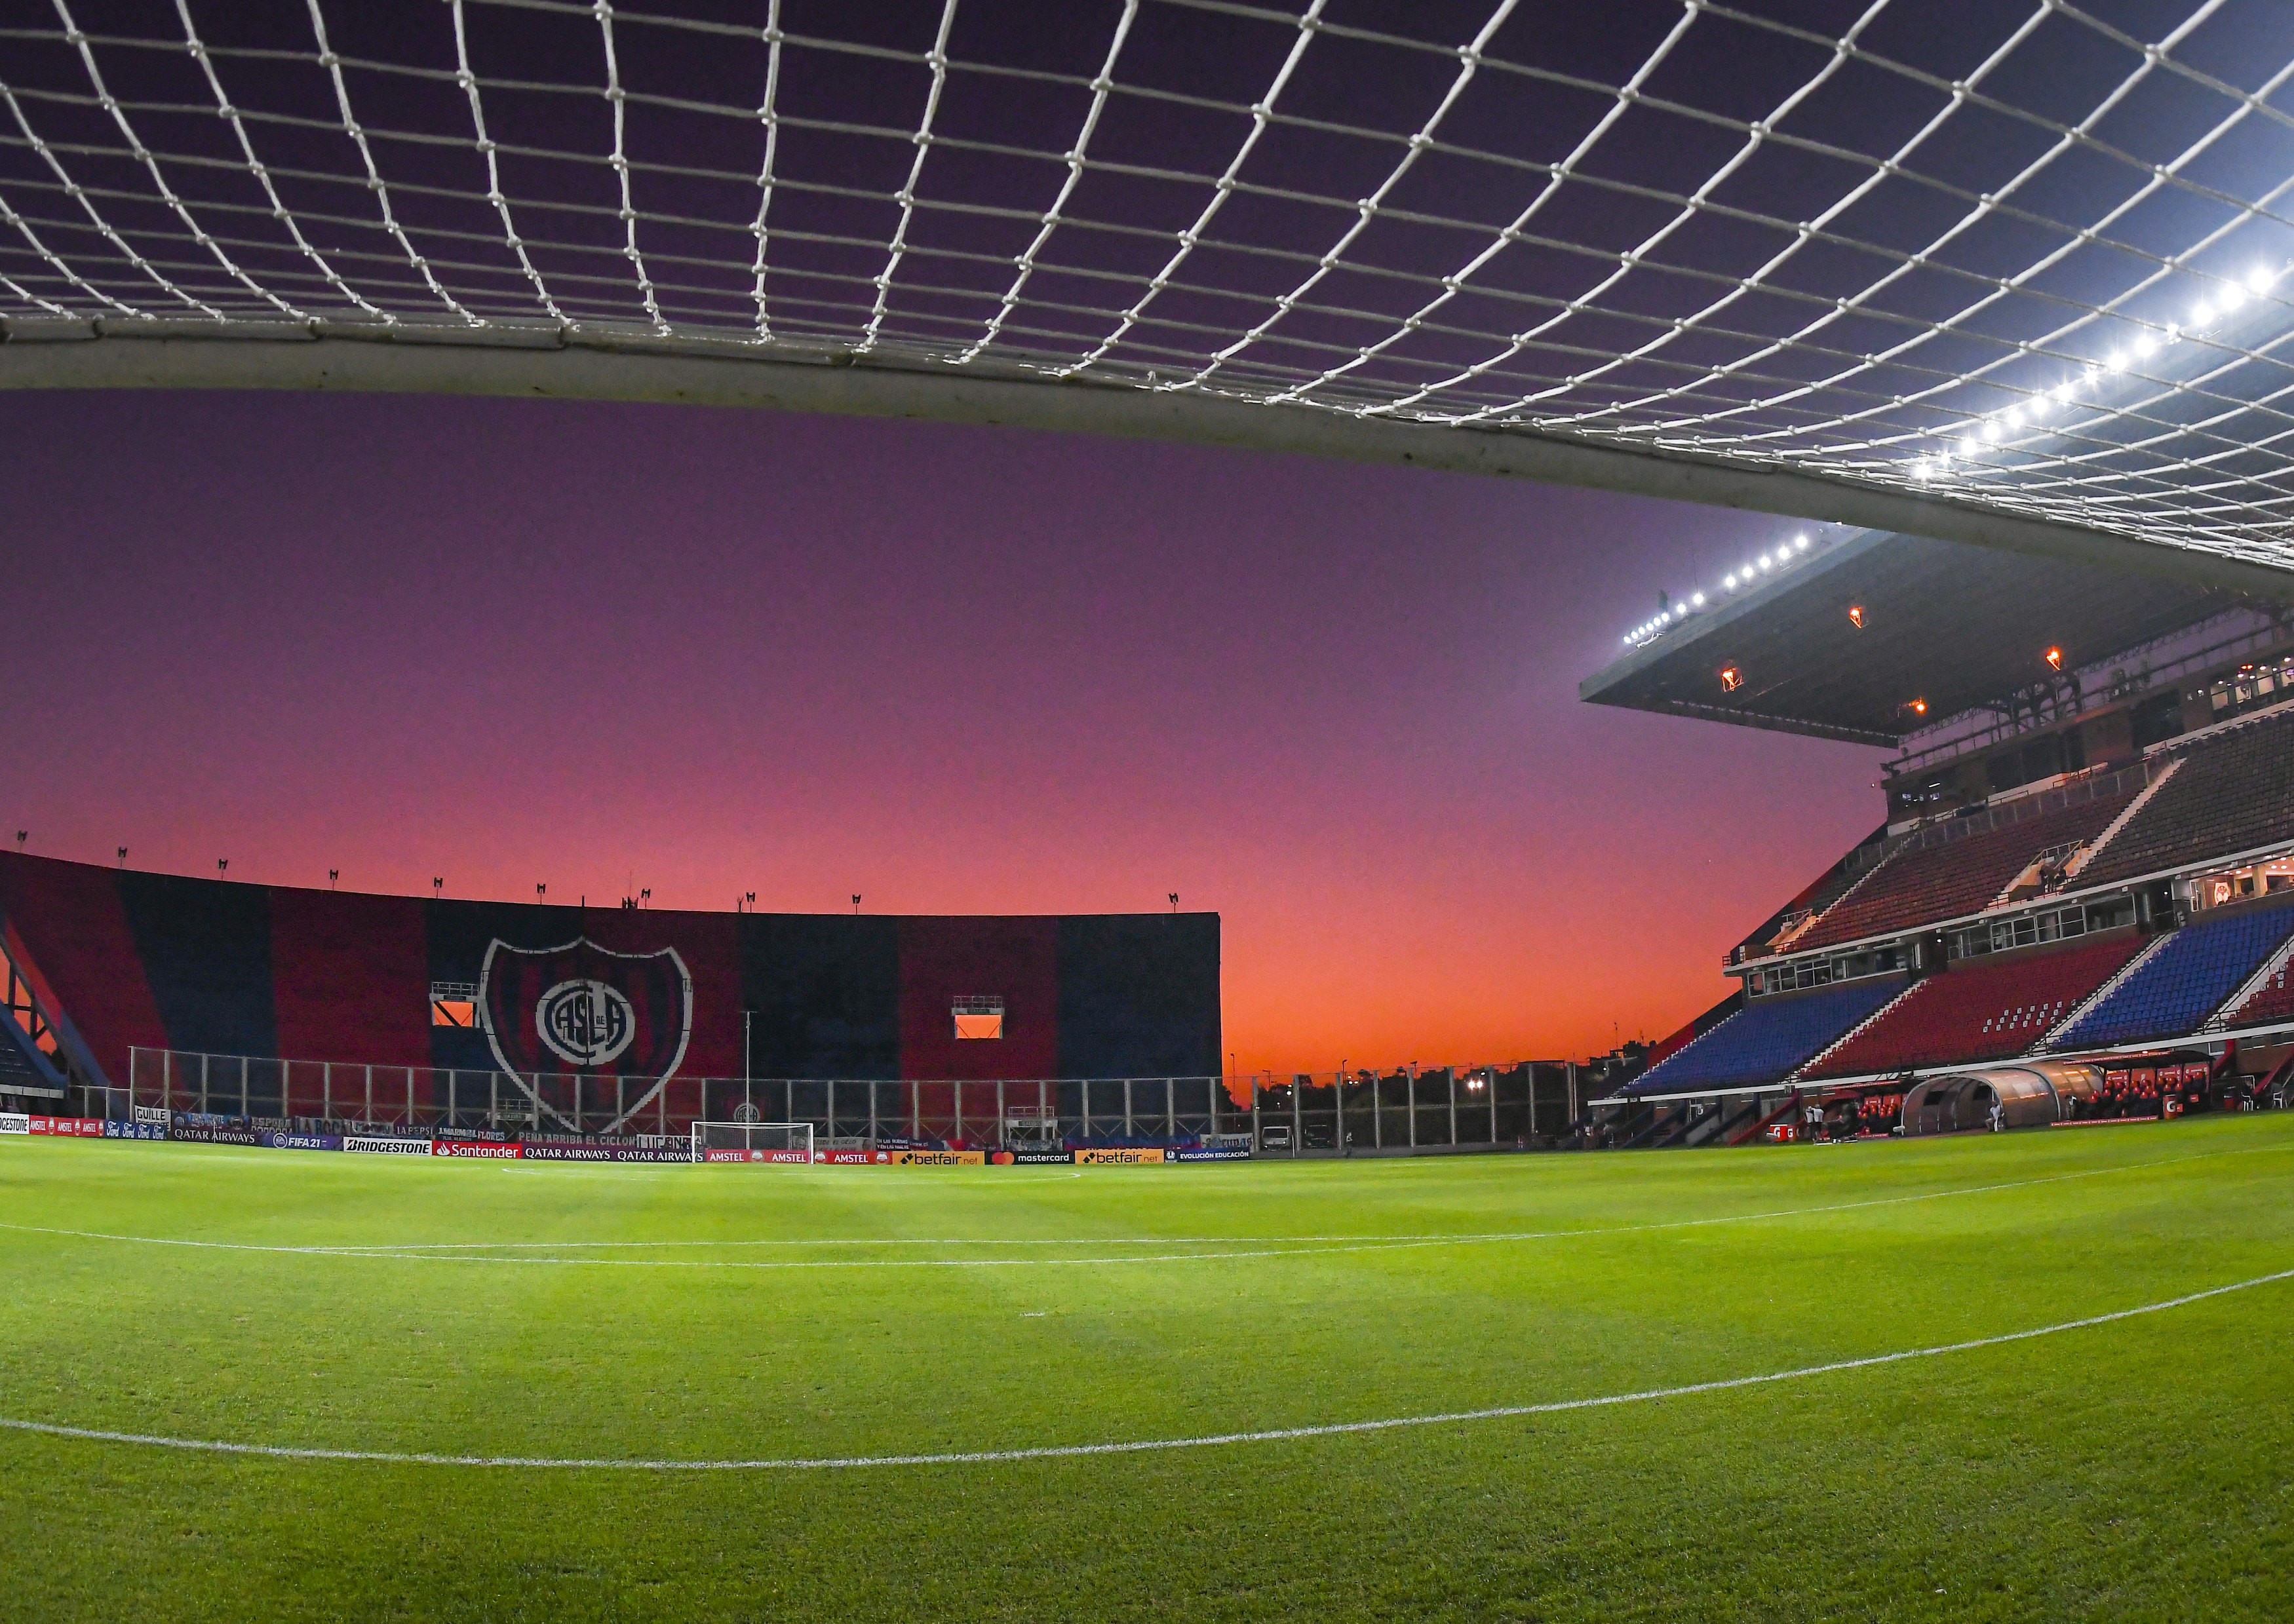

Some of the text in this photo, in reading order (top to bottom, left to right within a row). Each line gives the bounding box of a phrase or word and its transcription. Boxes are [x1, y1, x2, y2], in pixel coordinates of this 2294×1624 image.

[2166, 1100, 2176, 1113] G
[30, 1120, 46, 1131] AMSTEL
[58, 1122, 72, 1132] AMSTEL
[83, 1123, 96, 1132] AMSTEL
[106, 1121, 119, 1137] Ford
[122, 1122, 135, 1138] Ford
[138, 1123, 150, 1138] Ford
[397, 1126, 406, 1134] LA
[408, 1127, 433, 1135] PEPSI
[153, 1125, 164, 1140] Ford
[174, 1129, 255, 1144] QATAR AIRWAYS
[478, 1130, 505, 1140] FLORES
[1787, 1128, 1793, 1138] G
[288, 1137, 321, 1148] FIFA 21
[586, 1135, 596, 1145] EL
[347, 1139, 430, 1153] BRIDGESTONE
[452, 1144, 517, 1158] Santander
[525, 1148, 610, 1159] QATAR AIRWAYS
[617, 1151, 654, 1161] QATAR
[710, 1153, 744, 1161] AMSTEL
[772, 1153, 806, 1162] AMSTEL
[834, 1154, 868, 1163] AMSTEL
